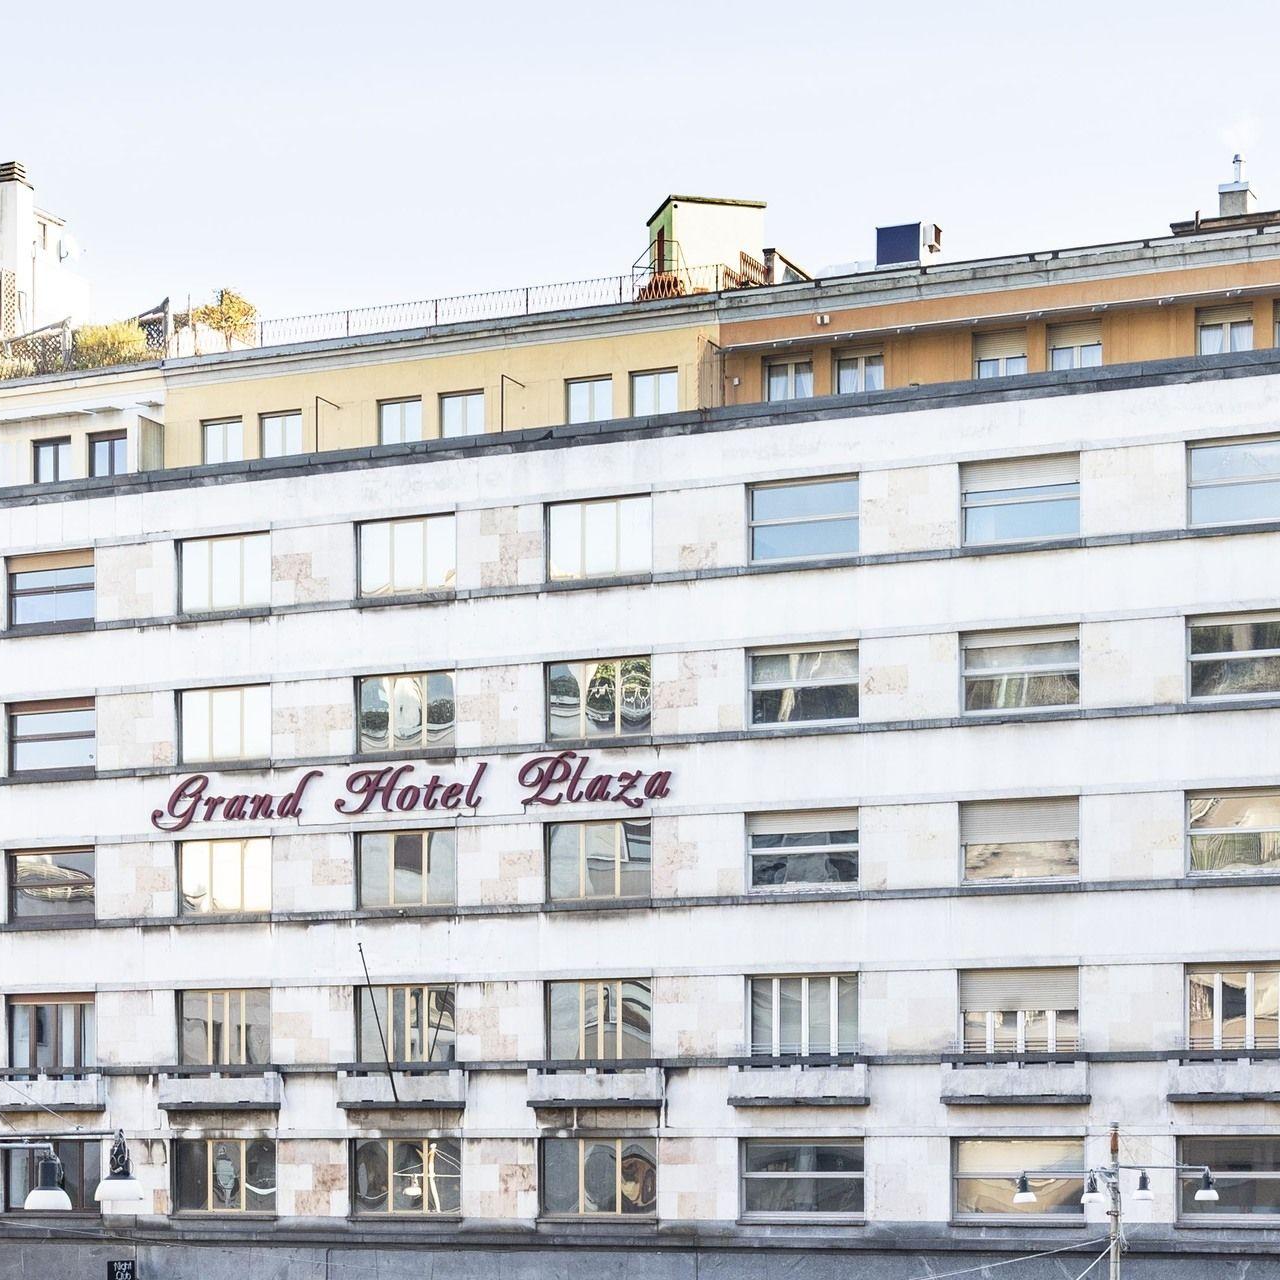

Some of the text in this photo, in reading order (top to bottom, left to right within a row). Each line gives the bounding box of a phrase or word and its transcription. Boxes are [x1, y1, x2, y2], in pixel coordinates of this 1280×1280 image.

[151, 750, 671, 832] Grand Hotel Plaza
[113, 1261, 132, 1273] Night
[115, 1271, 132, 1280] Club
